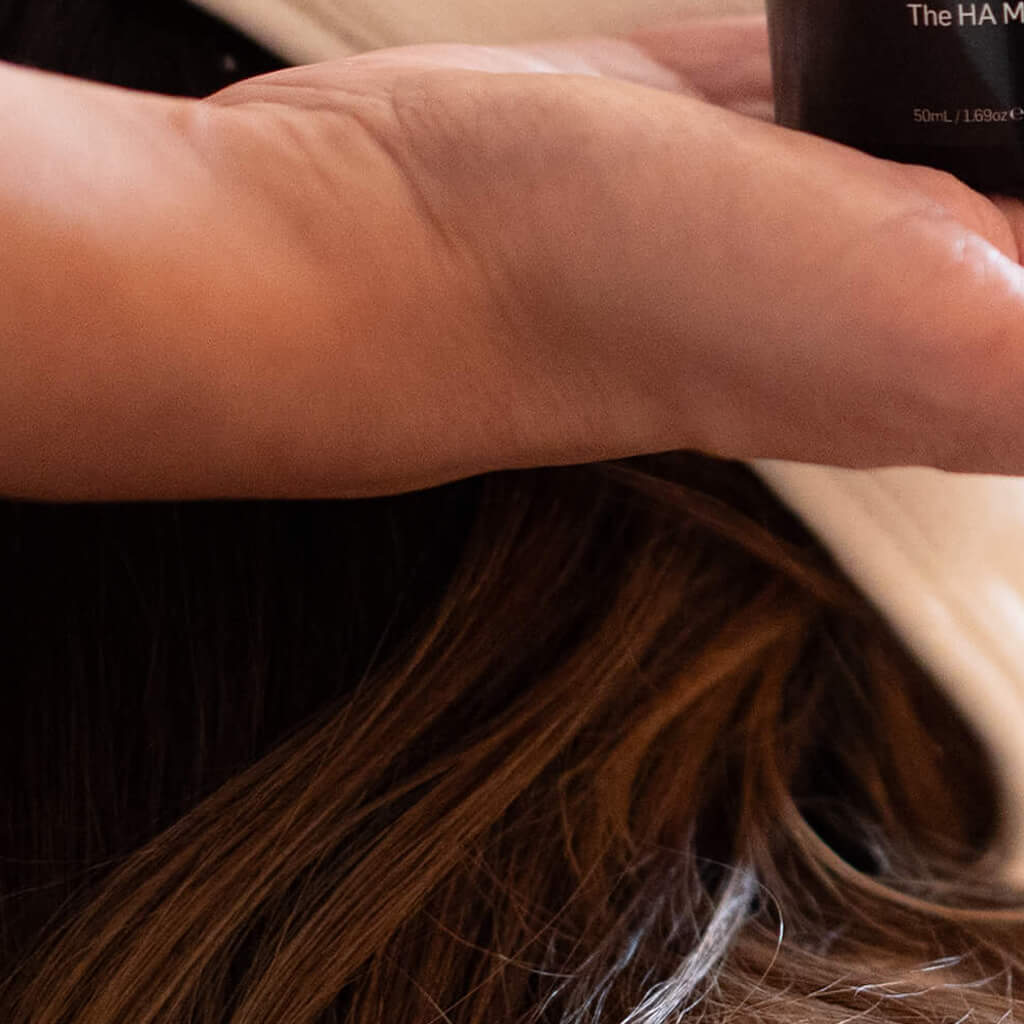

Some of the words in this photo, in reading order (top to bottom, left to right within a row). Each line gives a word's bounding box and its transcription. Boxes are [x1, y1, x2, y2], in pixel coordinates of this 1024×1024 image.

[906, 3, 952, 26] The
[957, 2, 997, 26] HA
[913, 108, 952, 123] 50mL
